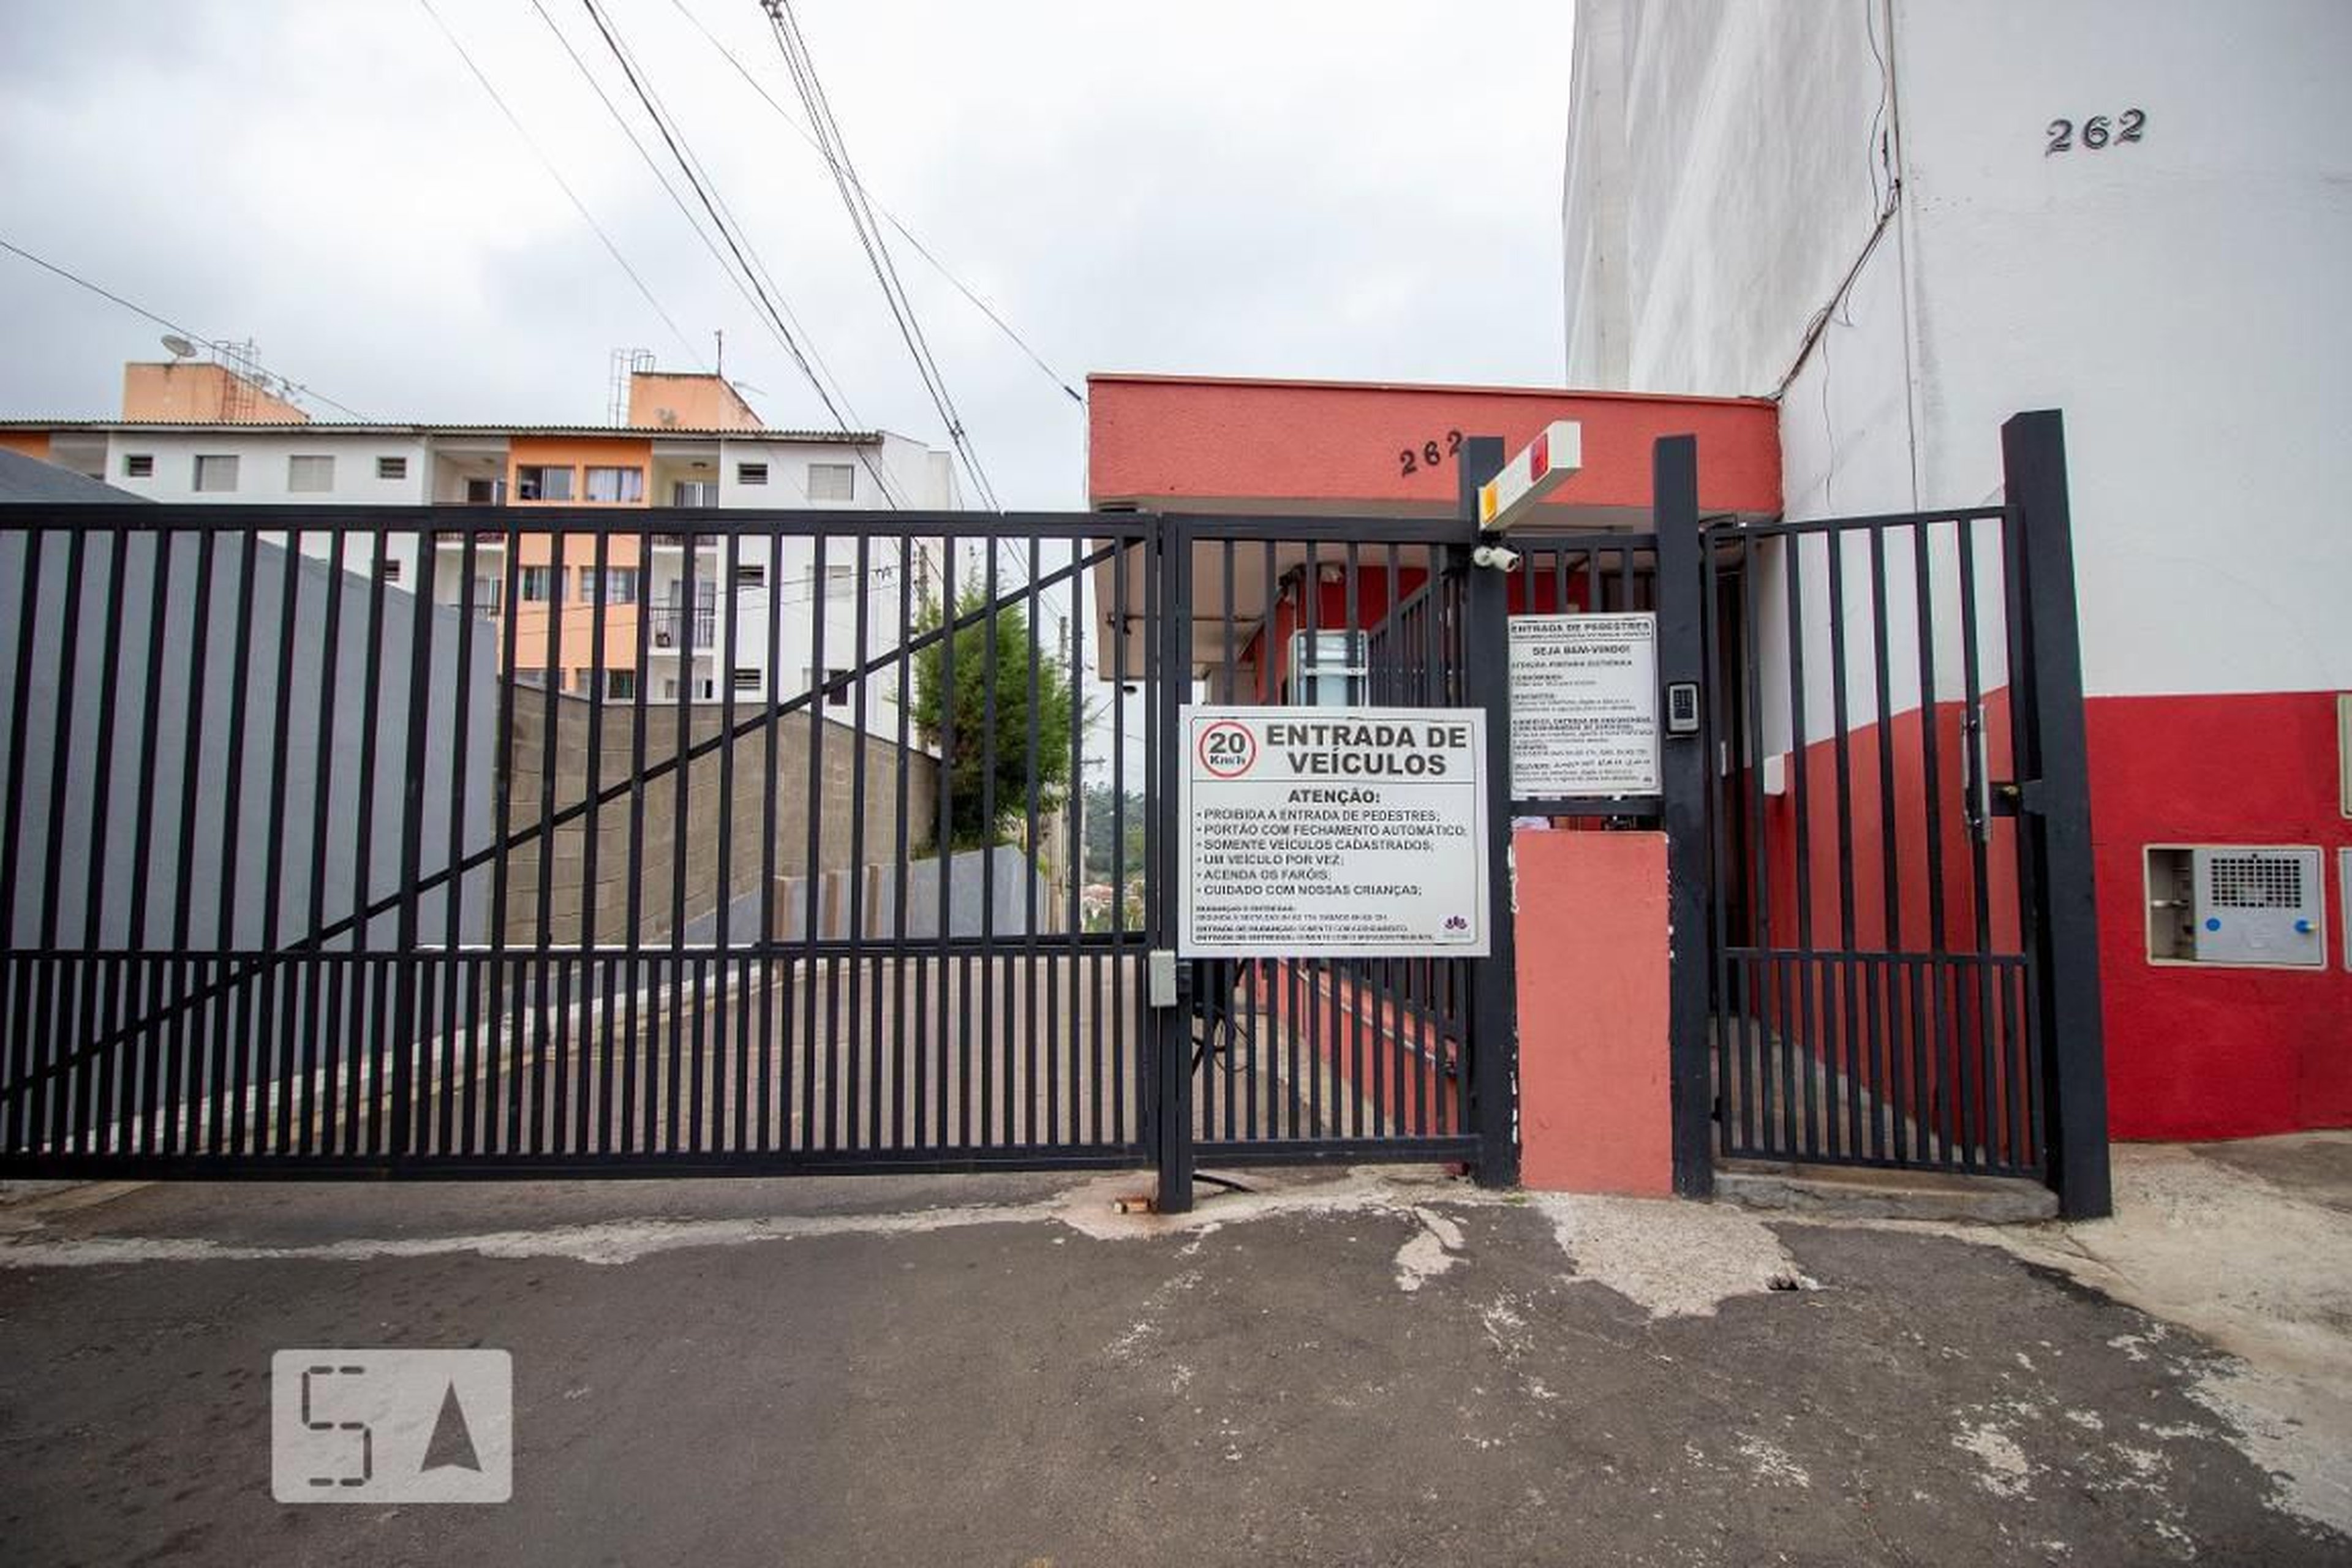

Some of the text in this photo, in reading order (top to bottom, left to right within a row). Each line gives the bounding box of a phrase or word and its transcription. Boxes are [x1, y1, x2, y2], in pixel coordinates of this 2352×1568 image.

[2045, 108, 2146, 158] 262
[1400, 431, 1463, 478] 262
[1208, 733, 1246, 753] 20
[1267, 725, 1467, 748] ENTRADA DE
[1287, 747, 1446, 775] VEÍCULOS
[1288, 787, 1380, 806] ATENÇÃO:
[1204, 809, 1265, 820] PROIBIDA
[1268, 810, 1277, 820] A
[1280, 810, 1340, 821] ENTRADA
[1343, 810, 1359, 821] DE
[1204, 823, 1258, 835] PORTÃO
[1261, 824, 1289, 835] COM
[1294, 824, 1379, 835] FECHAMENTO
[1204, 839, 1266, 850] SOMENTE
[1270, 837, 1332, 850] VEÍCULOS
[1204, 854, 1224, 865] UM
[1286, 854, 1313, 865] POR
[1204, 870, 1256, 880] ACENDA
[1261, 870, 1278, 880] OS
[1204, 885, 1262, 895] CUIDADO
[1265, 885, 1295, 895] COM
[1298, 885, 1350, 895] NOSSAS
